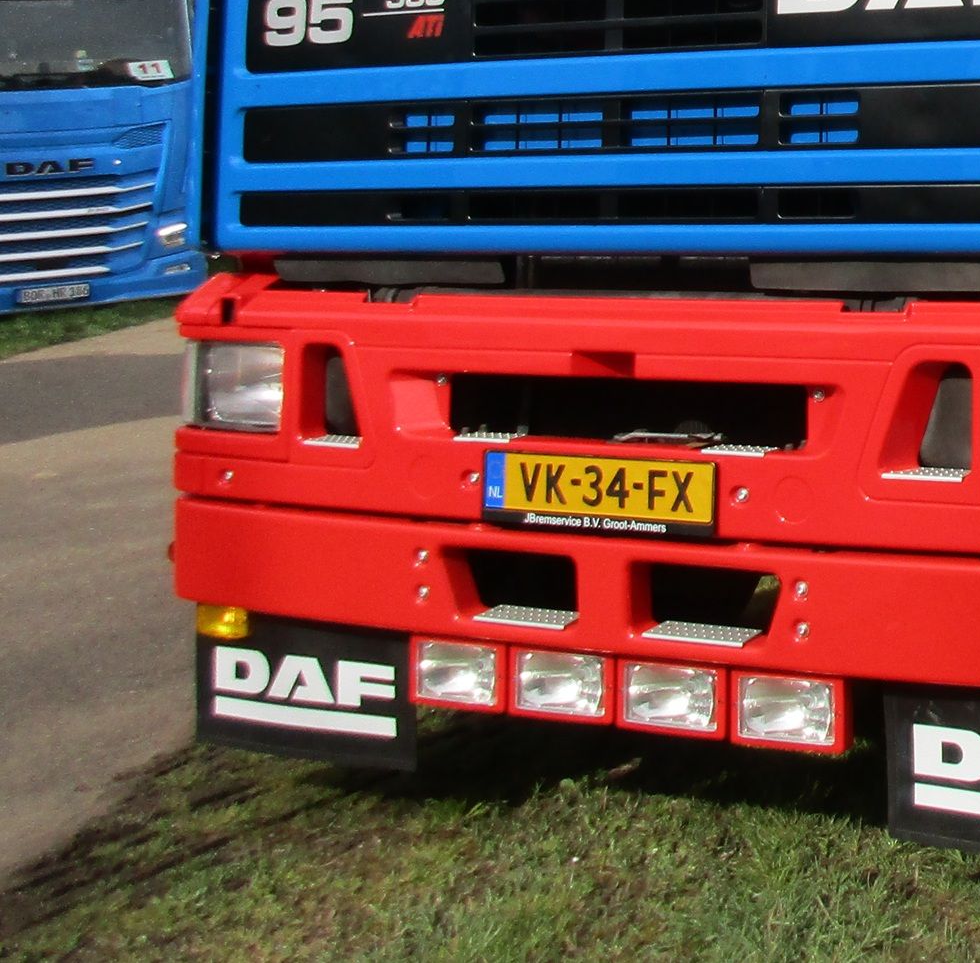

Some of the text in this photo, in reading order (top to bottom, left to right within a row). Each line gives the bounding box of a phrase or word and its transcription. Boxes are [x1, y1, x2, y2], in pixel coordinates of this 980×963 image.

[138, 63, 161, 74] 11
[6, 158, 95, 176] DAF
[489, 486, 503, 499] NL
[520, 462, 694, 513] VK-34-FX
[583, 516, 600, 528] B.V.
[603, 519, 667, 533] Groot-Ammers
[215, 647, 396, 707] DAF
